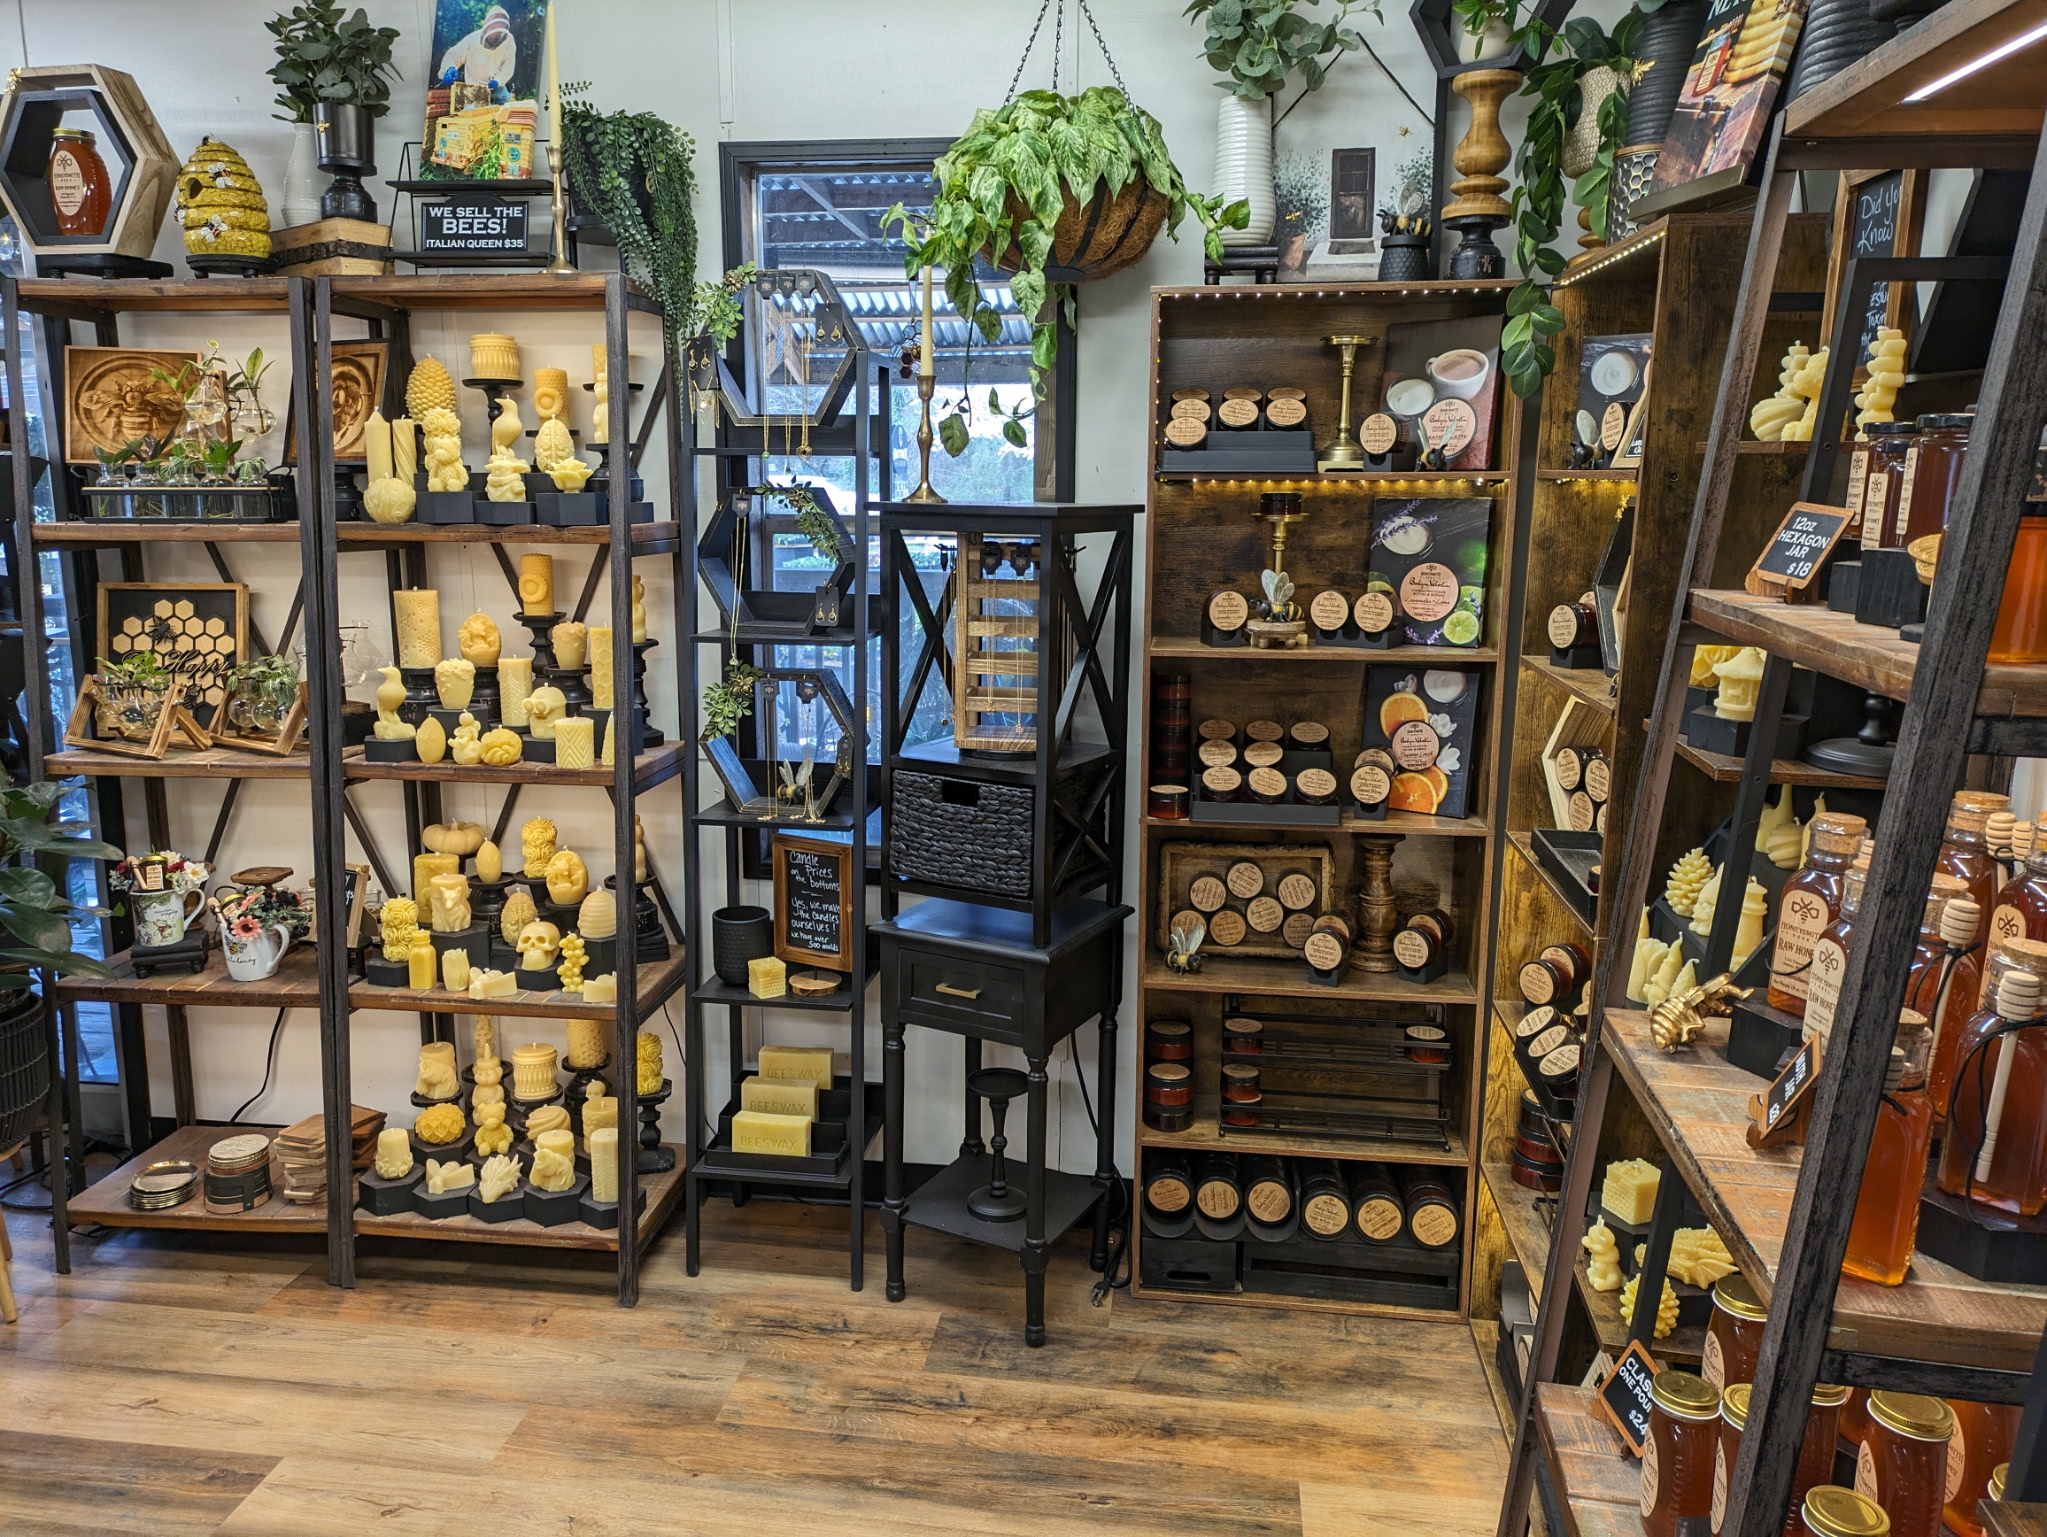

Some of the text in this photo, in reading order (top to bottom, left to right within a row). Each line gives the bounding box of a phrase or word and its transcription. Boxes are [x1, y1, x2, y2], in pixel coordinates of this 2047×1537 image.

[1861, 187, 1882, 219] Did
[429, 206, 523, 217] WE SELL THE
[442, 218, 507, 234] BEES!
[426, 238, 523, 249] ITALIAN QUEEN $35
[1857, 220, 1894, 255] Know
[1792, 516, 1818, 532] 12oz
[1777, 529, 1831, 549] HEXAGON
[1785, 544, 1810, 558] JAR
[1786, 561, 1813, 577] $18
[161, 649, 229, 680] Happy
[789, 851, 819, 866] Candle
[790, 868, 799, 877] on
[804, 865, 833, 878] Prices
[795, 875, 840, 891] the bottoms
[791, 896, 809, 916] Yes,
[809, 901, 821, 909] we
[799, 910, 810, 919] the
[1780, 921, 1821, 940] HONEYSMIT
[1778, 937, 1815, 960] RAW HONE
[767, 1068, 823, 1081] BEESWAX
[750, 1100, 807, 1114] BEESWAX
[740, 1136, 797, 1151] BEESWAX
[1618, 1366, 1637, 1390] ONE
[1628, 1409, 1649, 1436] $24
